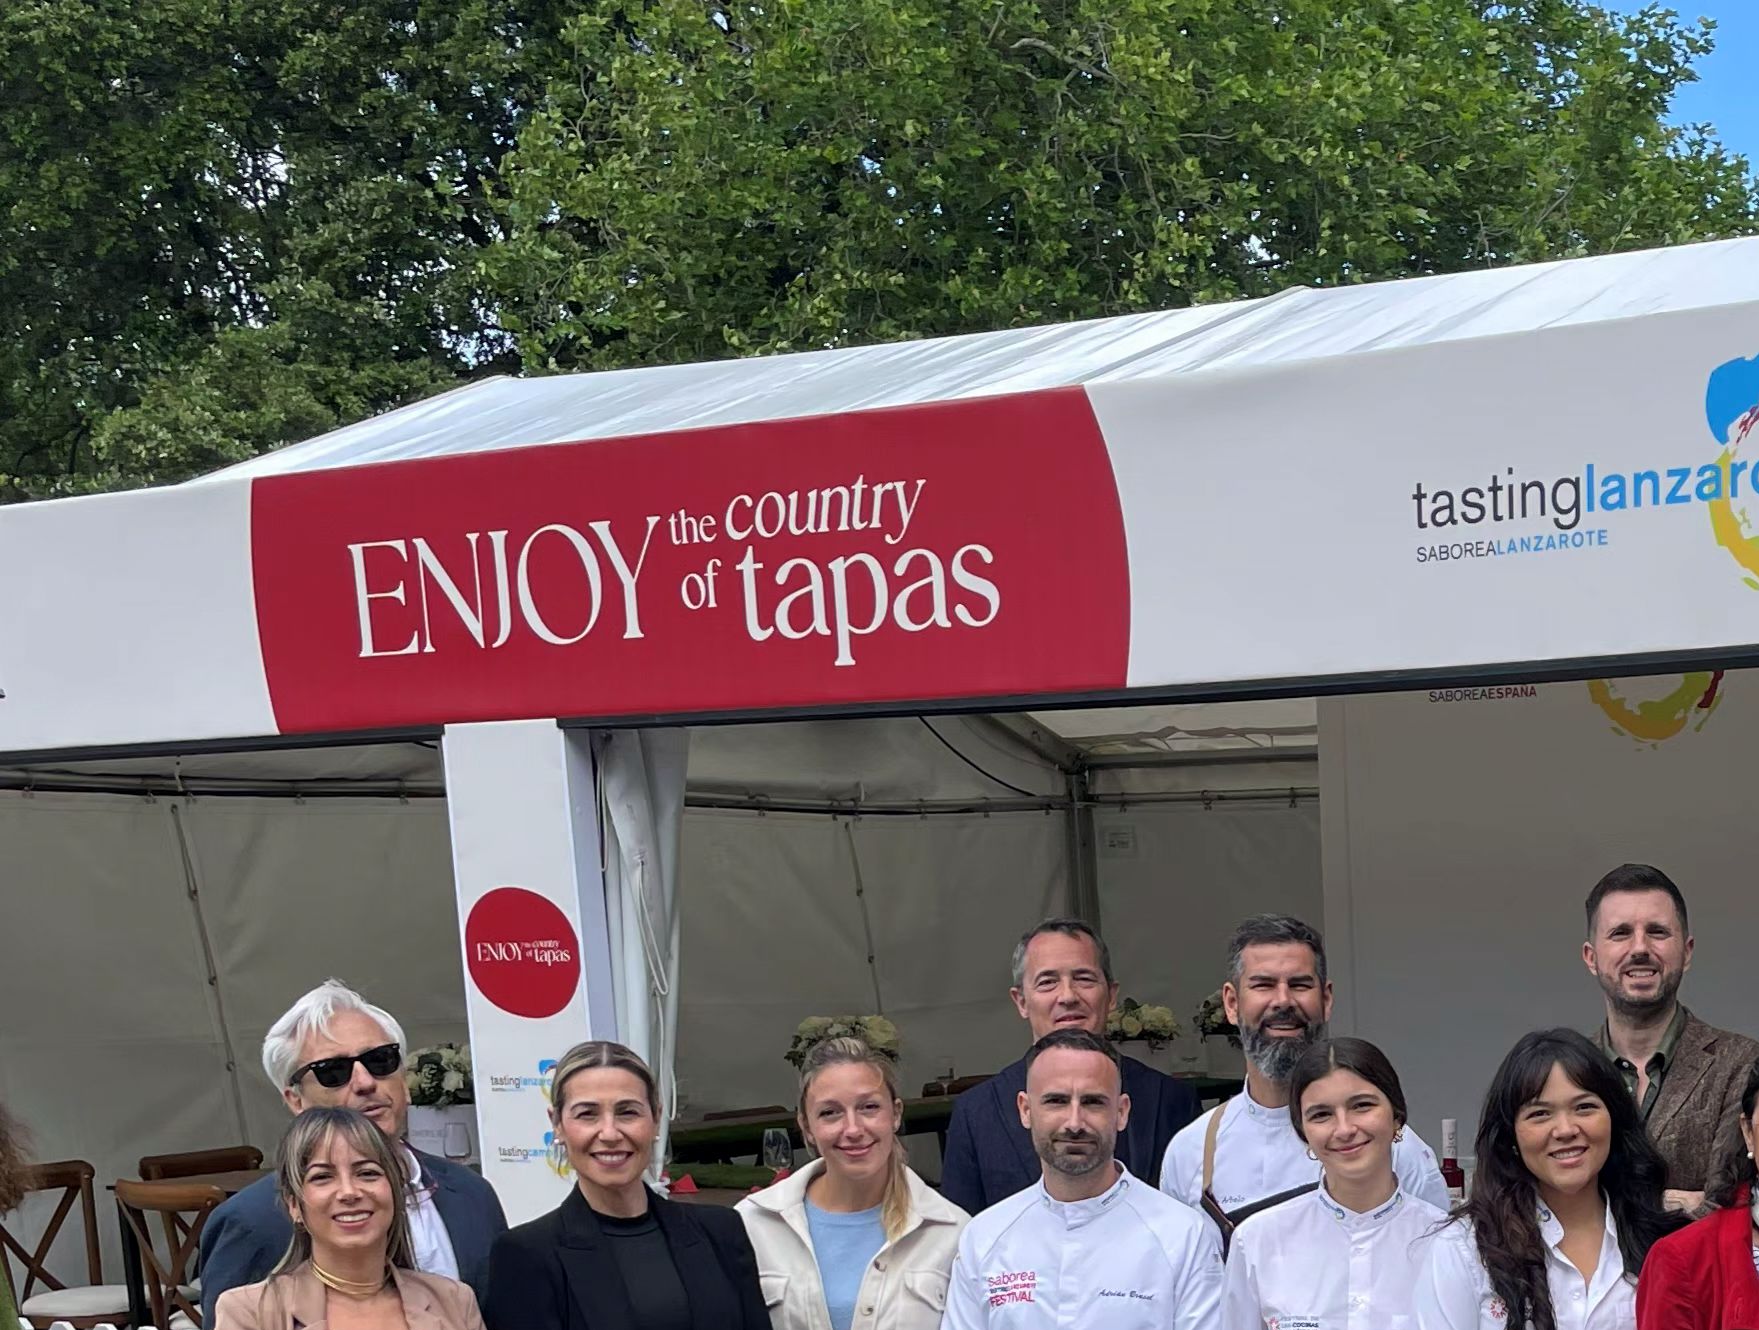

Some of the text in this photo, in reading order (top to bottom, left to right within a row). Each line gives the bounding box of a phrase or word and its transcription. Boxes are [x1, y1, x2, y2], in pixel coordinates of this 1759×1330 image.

[1416, 529, 1609, 562] SABOREALANZAROTE
[347, 474, 926, 657] ENJOY the country
[681, 545, 1000, 666] of tapas
[477, 942, 522, 961] ENJOY
[534, 948, 571, 966] tapas
[988, 1271, 1035, 1287] saborea
[989, 1291, 1035, 1307] FESTIVAL
